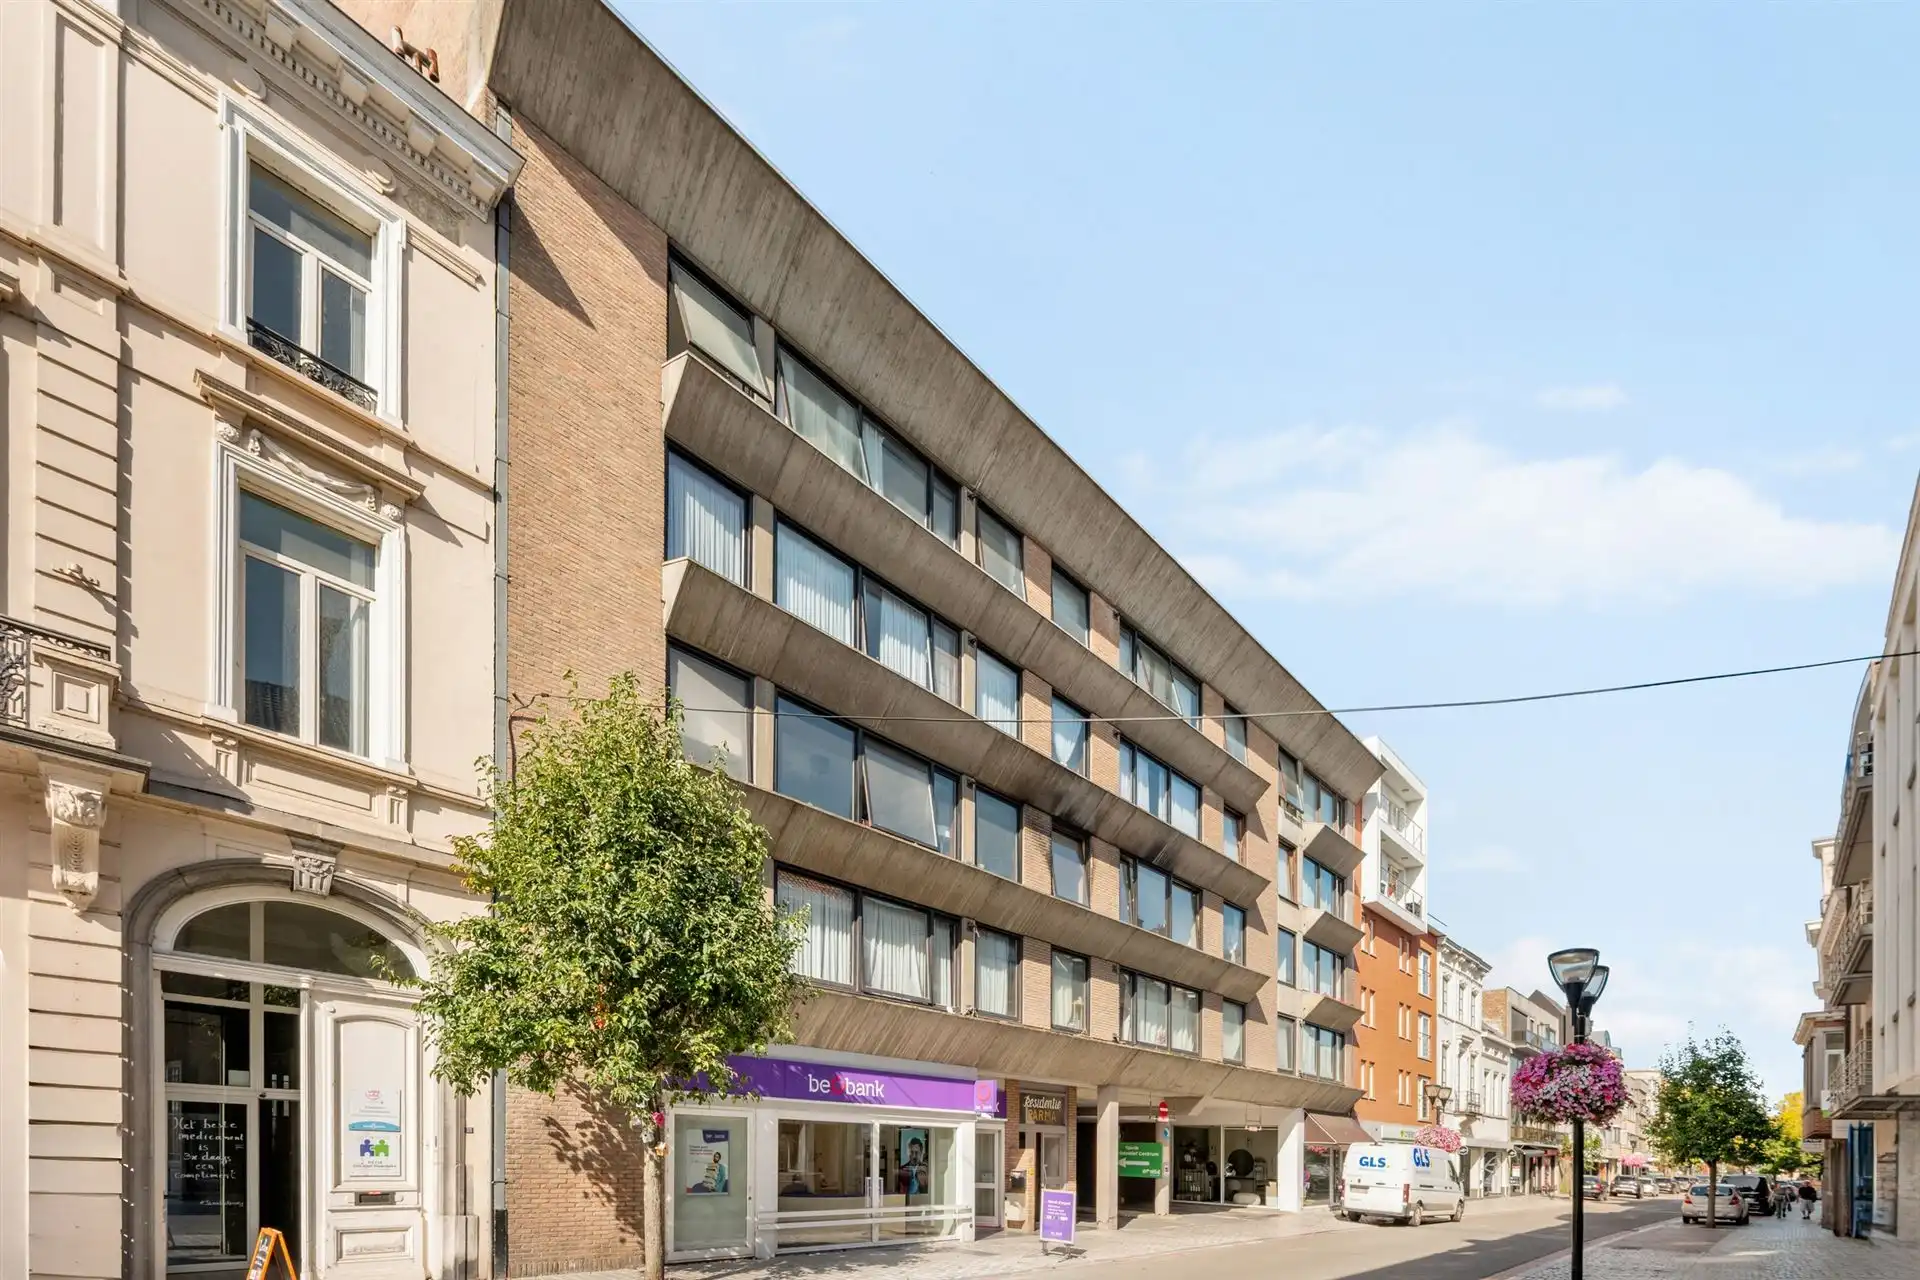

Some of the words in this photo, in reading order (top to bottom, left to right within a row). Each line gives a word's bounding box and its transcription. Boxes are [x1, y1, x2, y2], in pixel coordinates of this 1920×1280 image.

[1023, 1095, 1062, 1110] Residentie
[1029, 1109, 1057, 1121] PARMA
[173, 1117, 196, 1130] Het
[203, 1118, 238, 1129] beste
[178, 1131, 244, 1141] medicament
